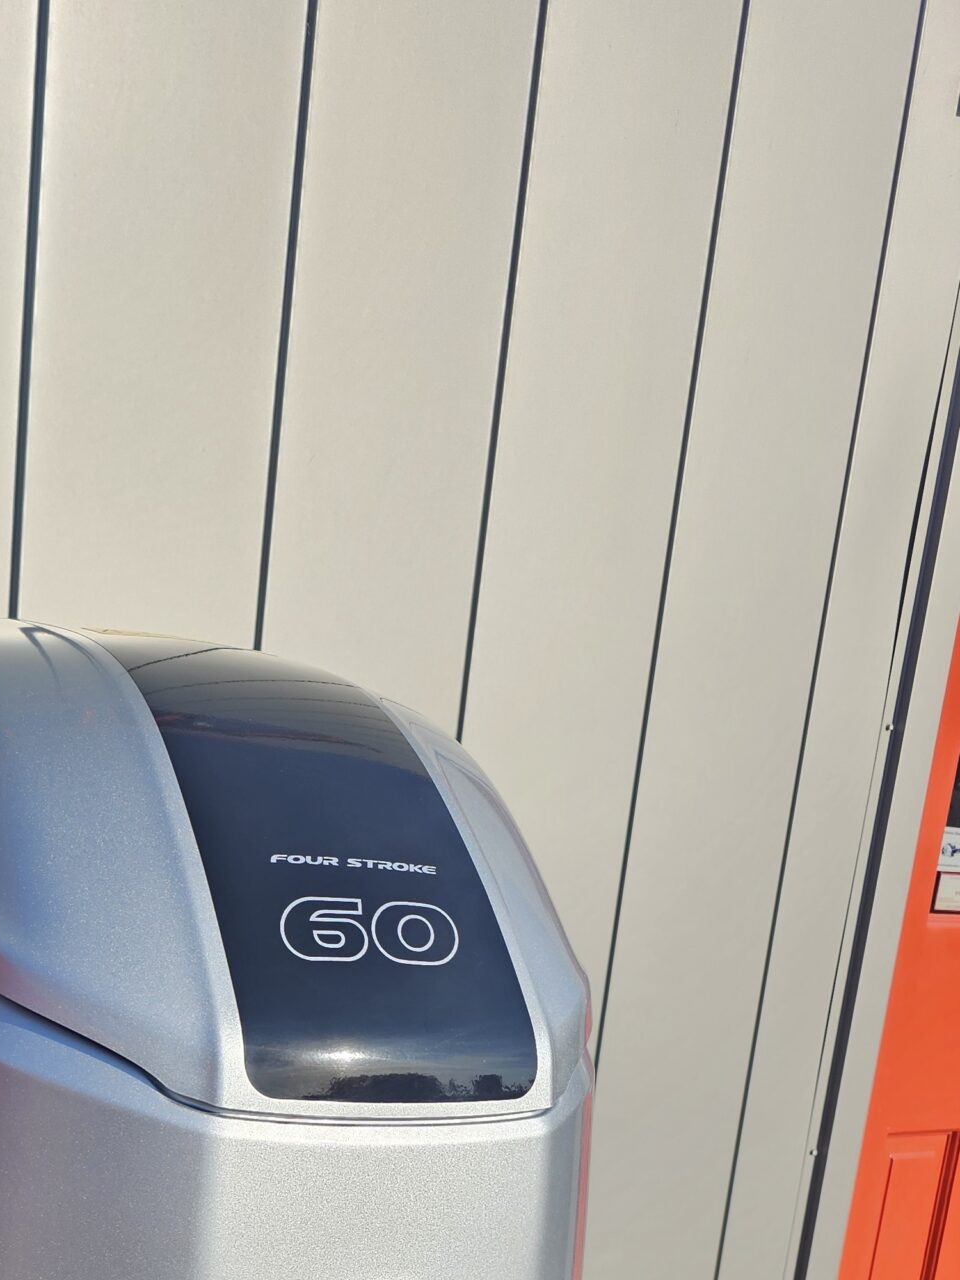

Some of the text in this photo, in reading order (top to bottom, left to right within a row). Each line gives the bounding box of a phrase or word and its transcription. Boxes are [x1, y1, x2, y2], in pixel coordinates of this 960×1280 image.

[270, 854, 437, 875] FOUR STROKE
[280, 896, 459, 966] 60
